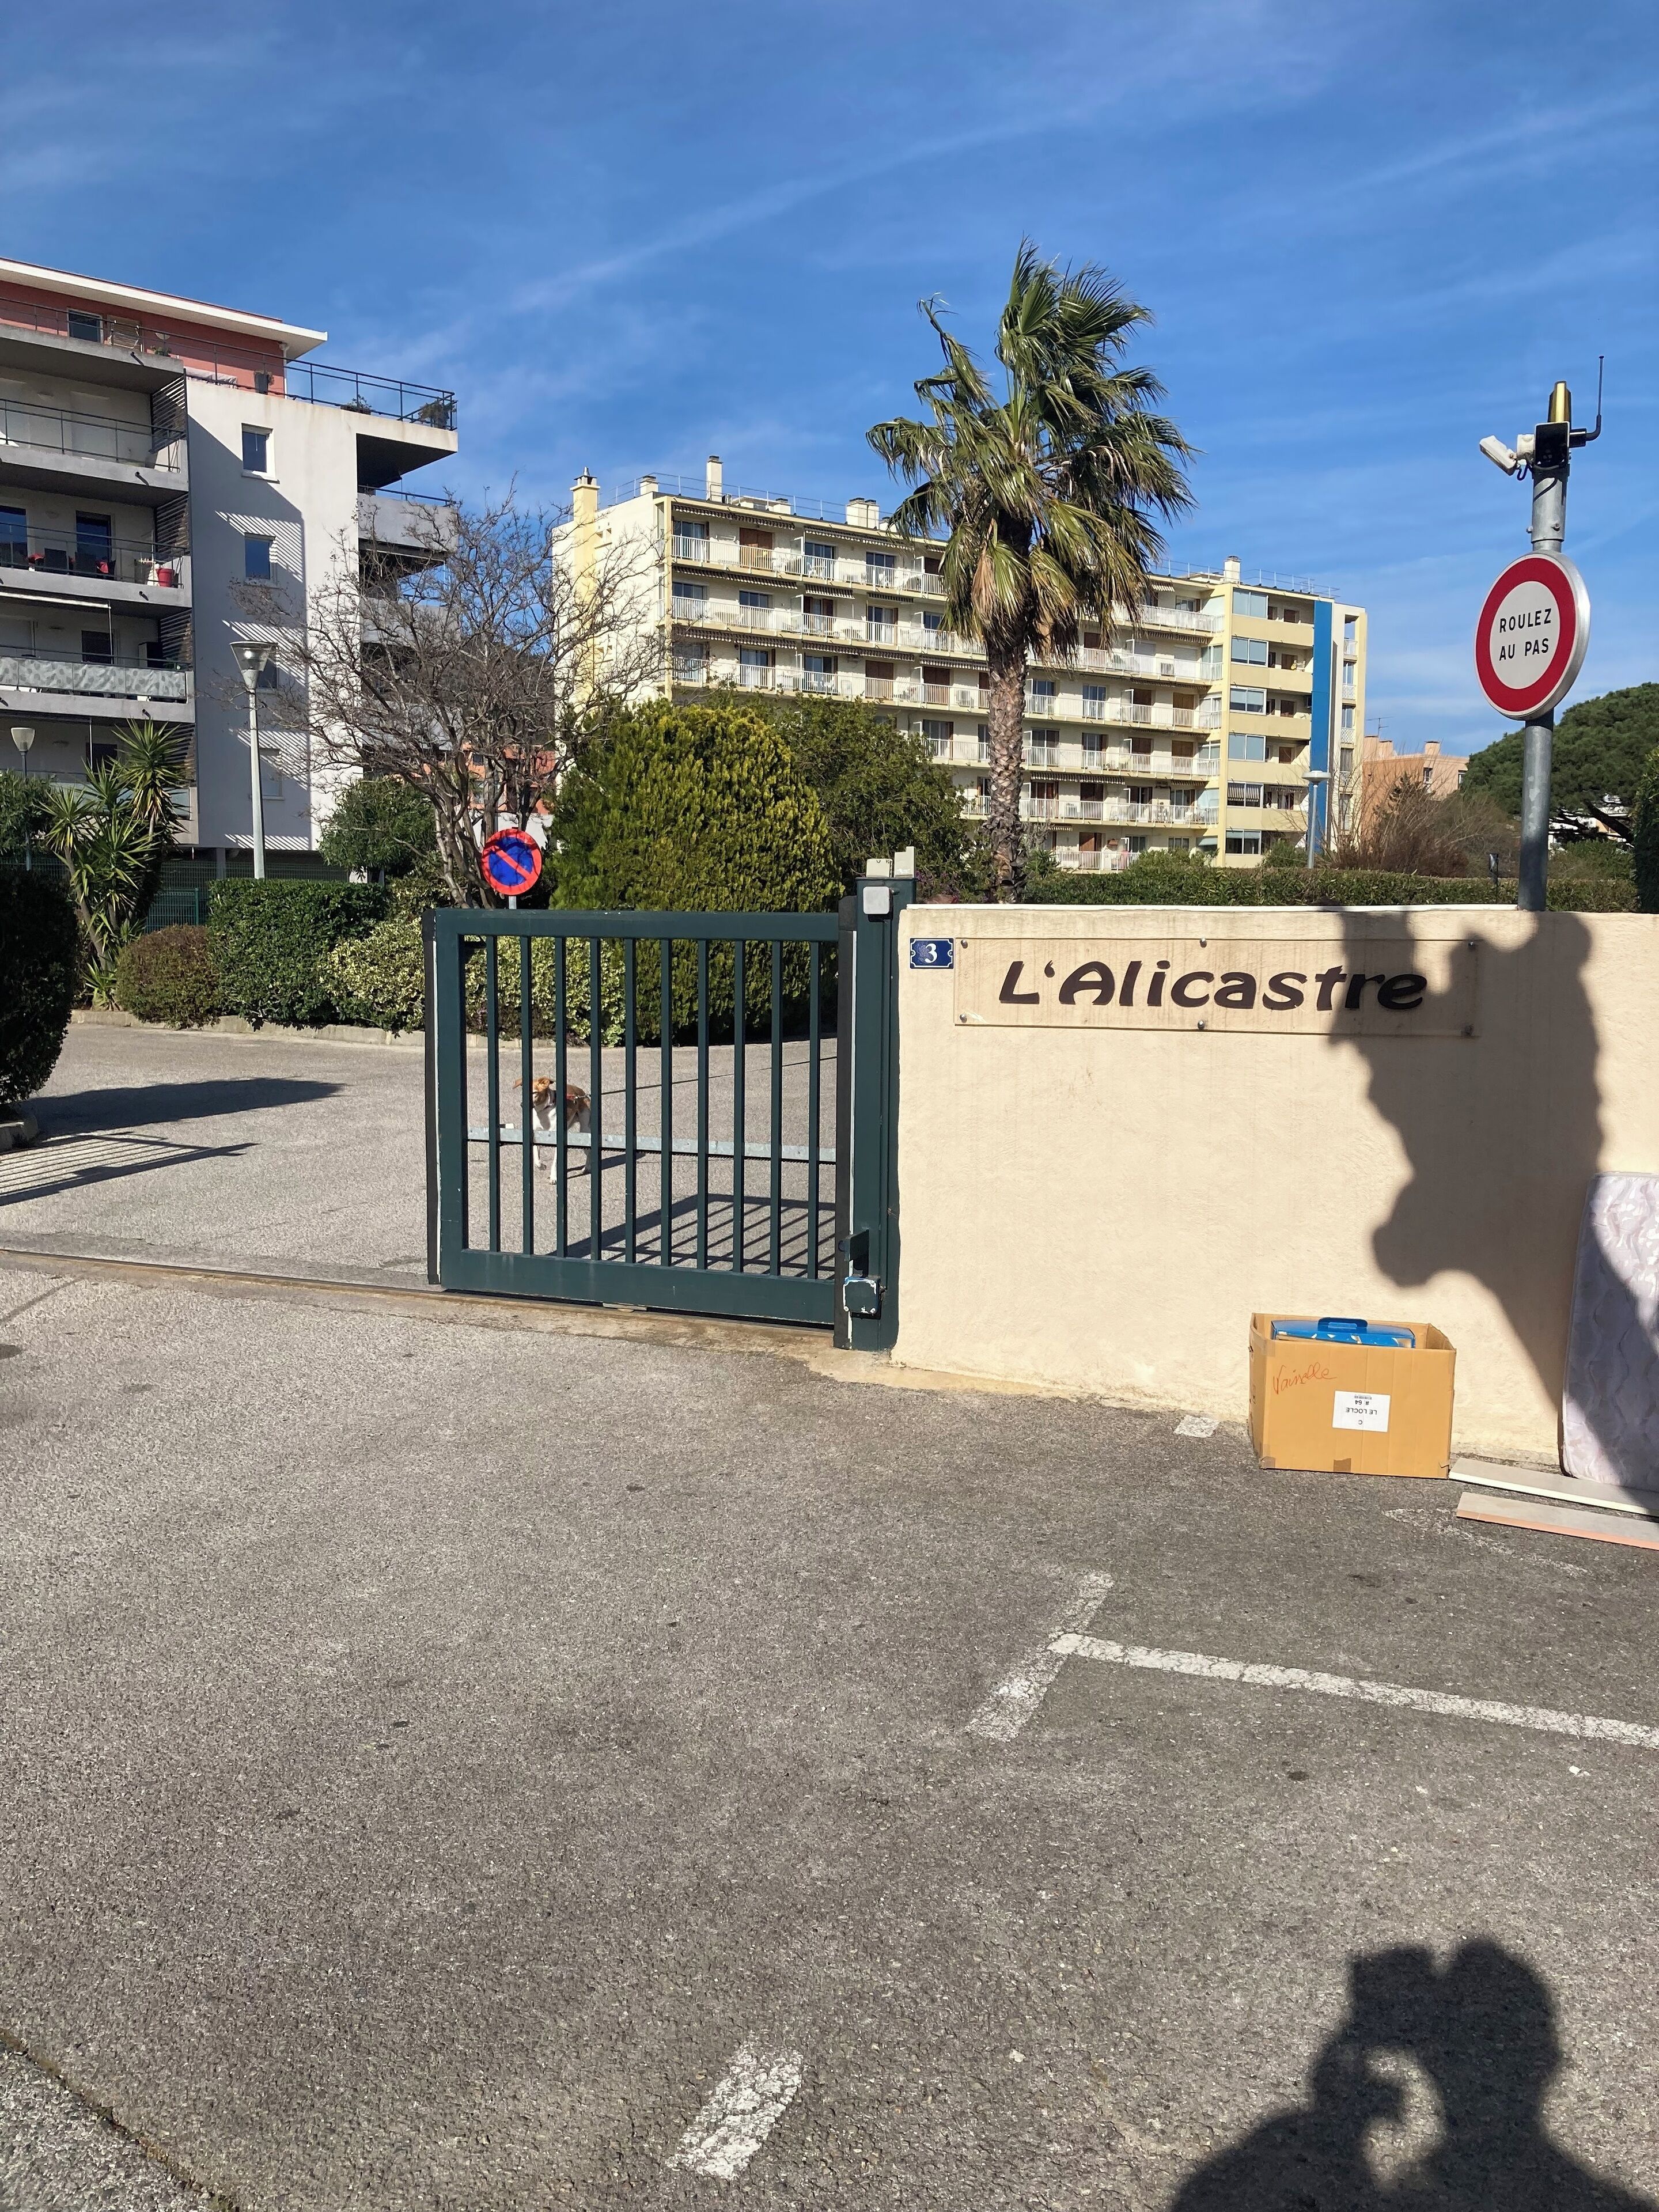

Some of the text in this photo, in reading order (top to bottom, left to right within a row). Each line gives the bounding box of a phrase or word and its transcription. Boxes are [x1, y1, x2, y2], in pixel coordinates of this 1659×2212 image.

[1499, 608, 1551, 632] ROULEZ
[1499, 638, 1549, 661] AU PAS
[925, 943, 938, 963] 3
[999, 960, 1427, 1012] L'Alicastre
